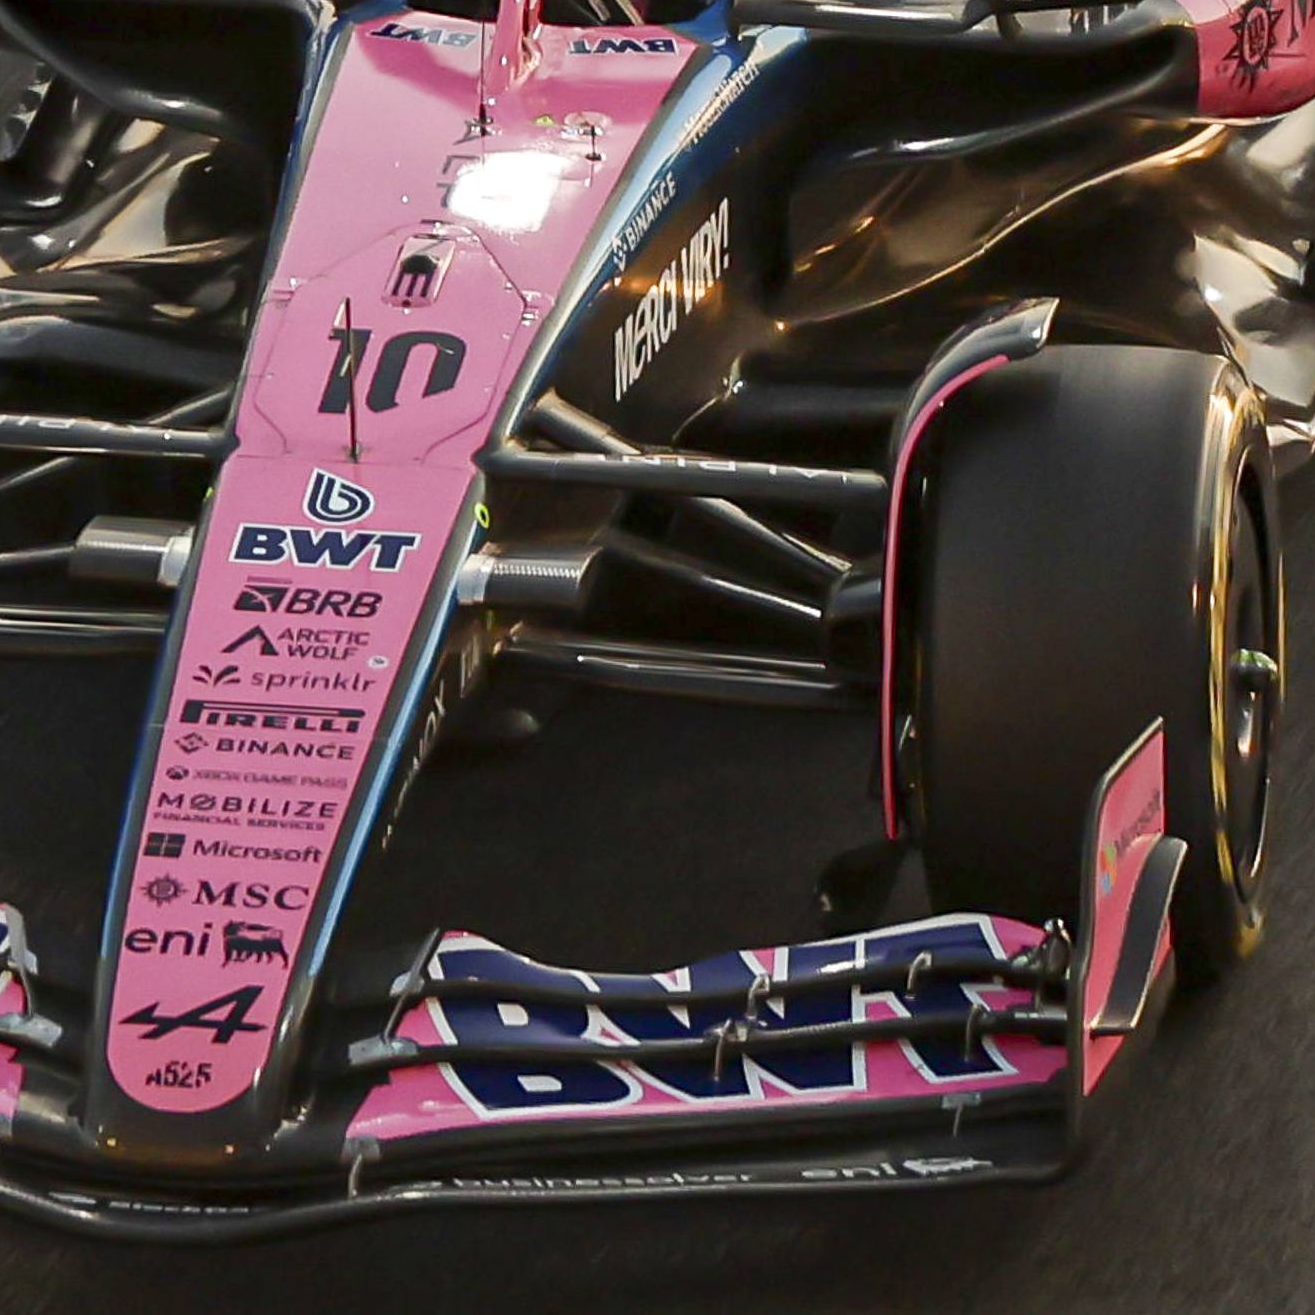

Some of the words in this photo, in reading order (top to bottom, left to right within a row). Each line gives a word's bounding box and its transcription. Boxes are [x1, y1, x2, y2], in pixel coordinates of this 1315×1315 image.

[626, 170, 676, 252] BINANCE
[317, 327, 466, 414] 10
[228, 523, 422, 573] BWT
[285, 588, 383, 619] BRB
[277, 628, 370, 646] ARCTIC
[286, 643, 359, 661] WOLF
[251, 668, 377, 693] sprinklr
[180, 699, 366, 733] PIRELLI
[216, 738, 355, 761] BINANCE
[192, 839, 323, 864] Microsoft
[191, 880, 310, 911] MSC
[124, 922, 213, 956] eni
